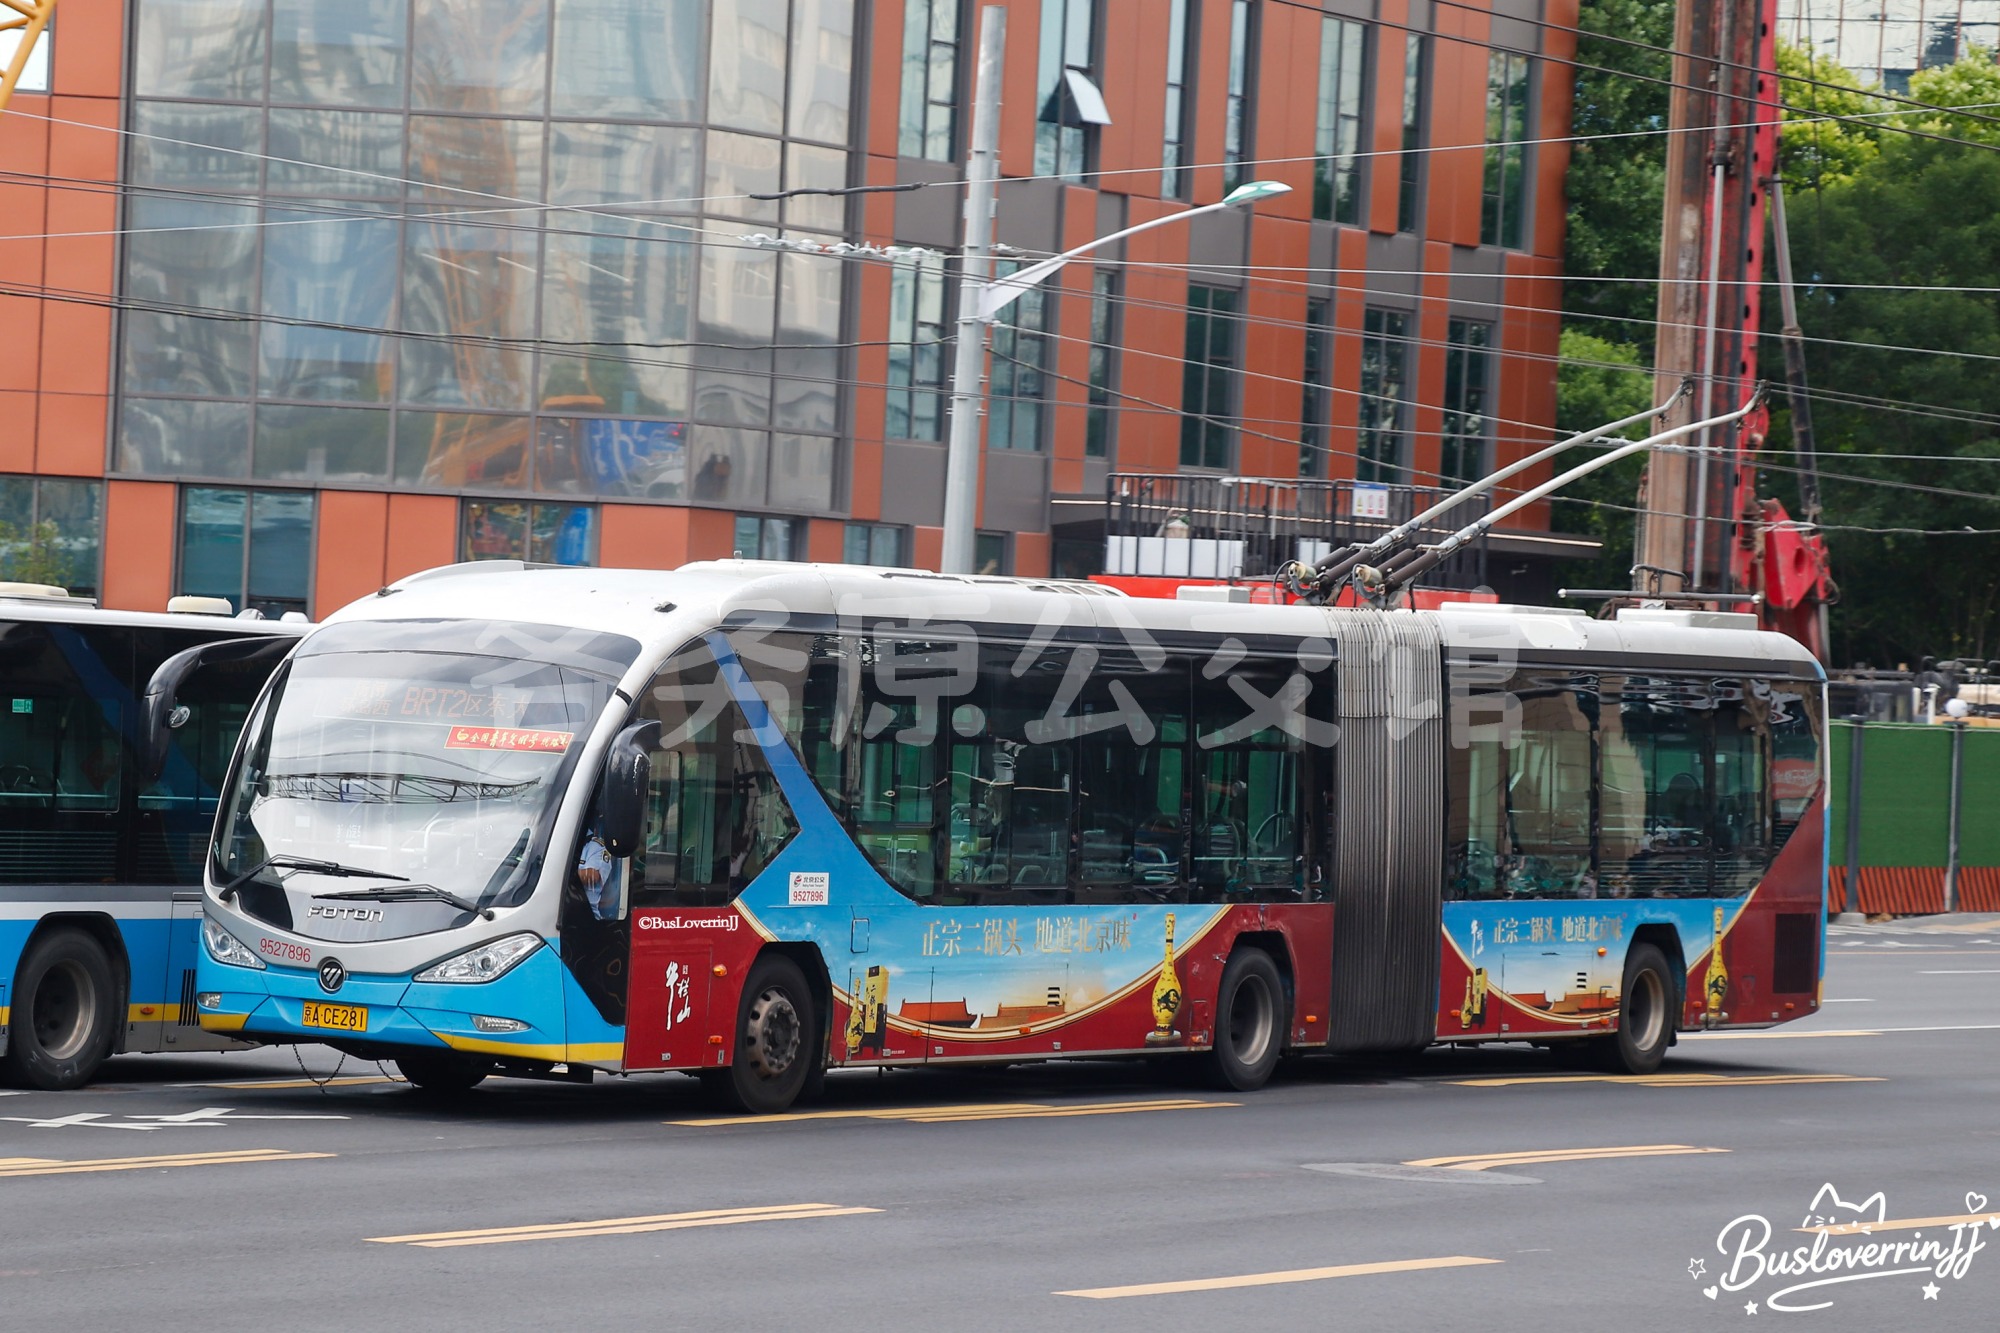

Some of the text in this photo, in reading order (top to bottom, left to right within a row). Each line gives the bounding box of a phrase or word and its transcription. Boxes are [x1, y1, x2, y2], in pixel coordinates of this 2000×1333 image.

[793, 890, 824, 902] 9527896
[307, 905, 384, 922] FOTON
[921, 916, 1132, 957] 正宗二锅头 地道北京味
[1493, 915, 1623, 944] 正宗二锅头 地道北京味
[260, 938, 311, 962] 9527896
